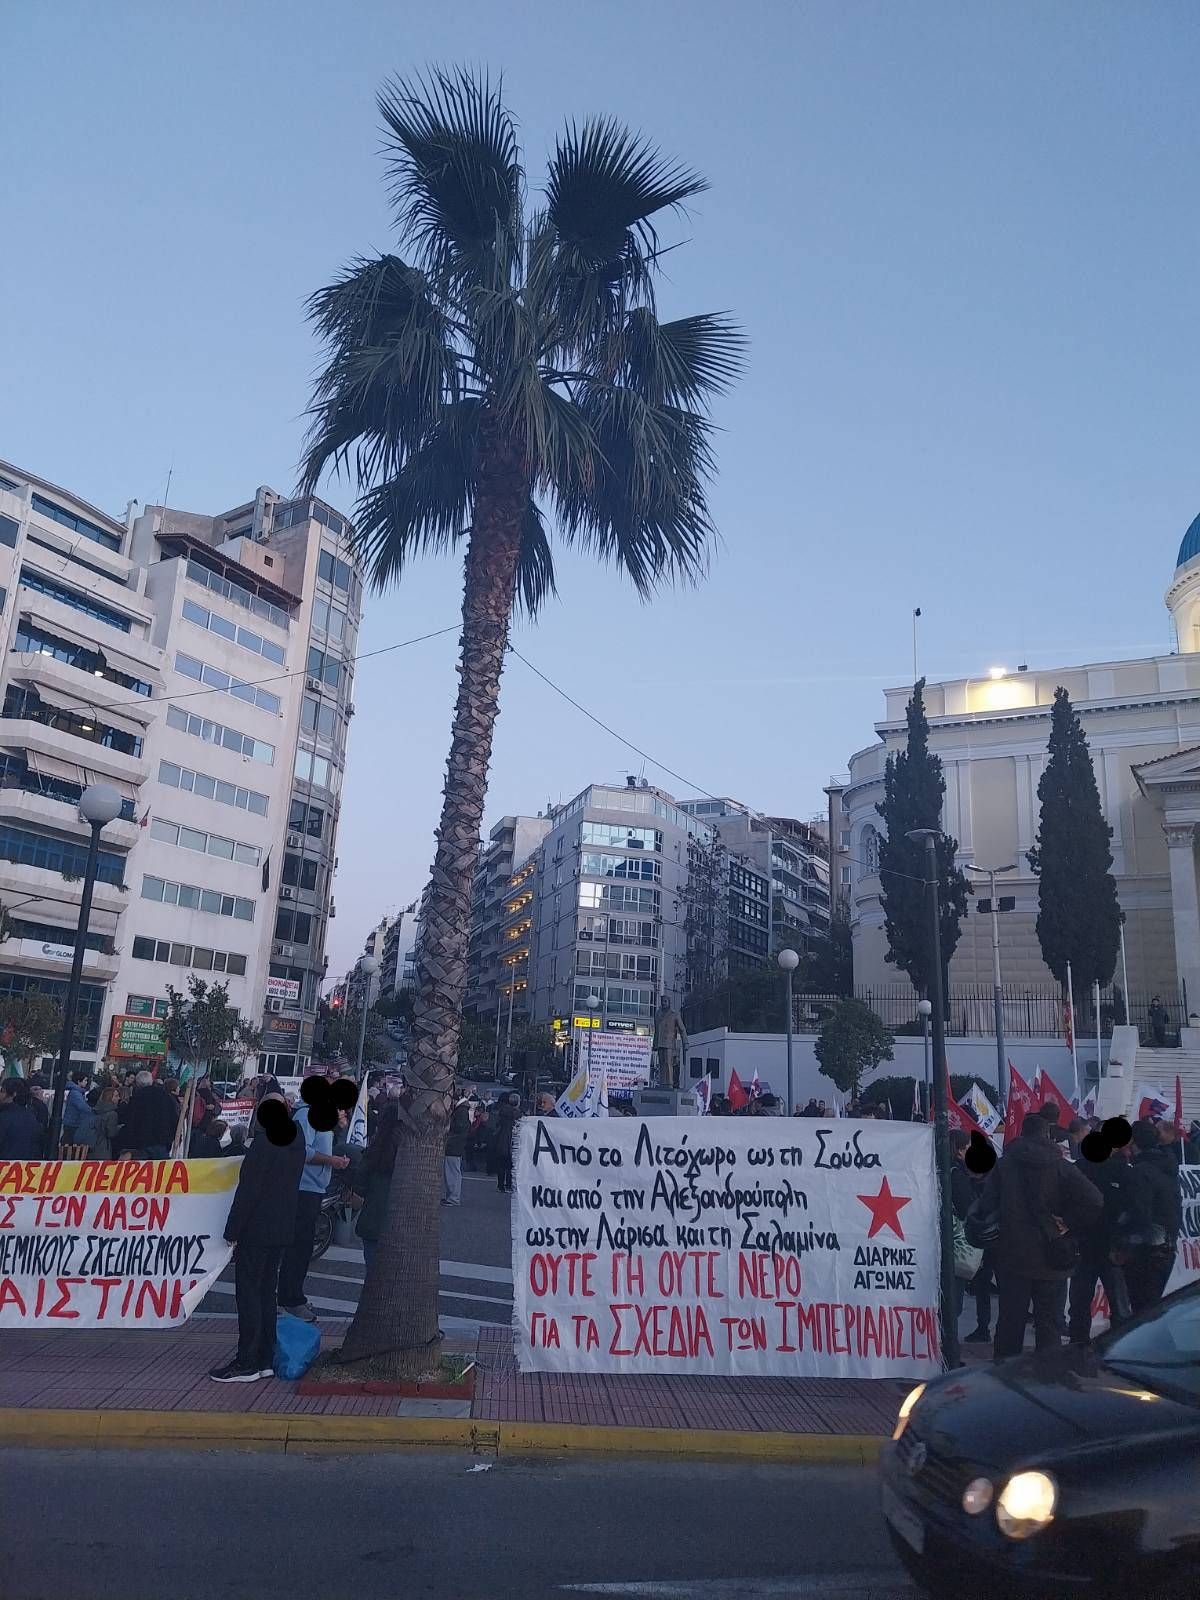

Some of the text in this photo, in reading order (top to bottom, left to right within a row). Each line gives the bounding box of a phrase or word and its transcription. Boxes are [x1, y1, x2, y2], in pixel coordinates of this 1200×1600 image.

[532, 1120, 882, 1176] Από το Λιτόχωρο ως τη Σούδα
[73, 1160, 189, 1194] ΠΕΙΡΑΙΑ
[531, 1169, 808, 1223] και από την Αλεξανδρούπολη
[32, 1195, 88, 1228] ΤΩΝ
[93, 1196, 170, 1231] ΛΑΩΝ
[526, 1211, 840, 1259] ως την Λάρισα και τη Σαλαμίνα
[79, 1234, 211, 1277] ΣΧΕΔΙΑΣΜΟΥΣ
[530, 1251, 802, 1299] ΟΥΤΕ ΓΗ ΟΥΤΕ ΝΕΡΟ
[853, 1246, 917, 1267] ΔΙΑΡΚΗΣ
[854, 1269, 916, 1291] ΑΓΩΝΑΣ
[531, 1301, 938, 1362] ΓΙΑ ΤΑ ΣΧΕΔΙΑ ΤΩΝ ΙΜΠΕΡΙΑΛΙΣΤΩΝ
